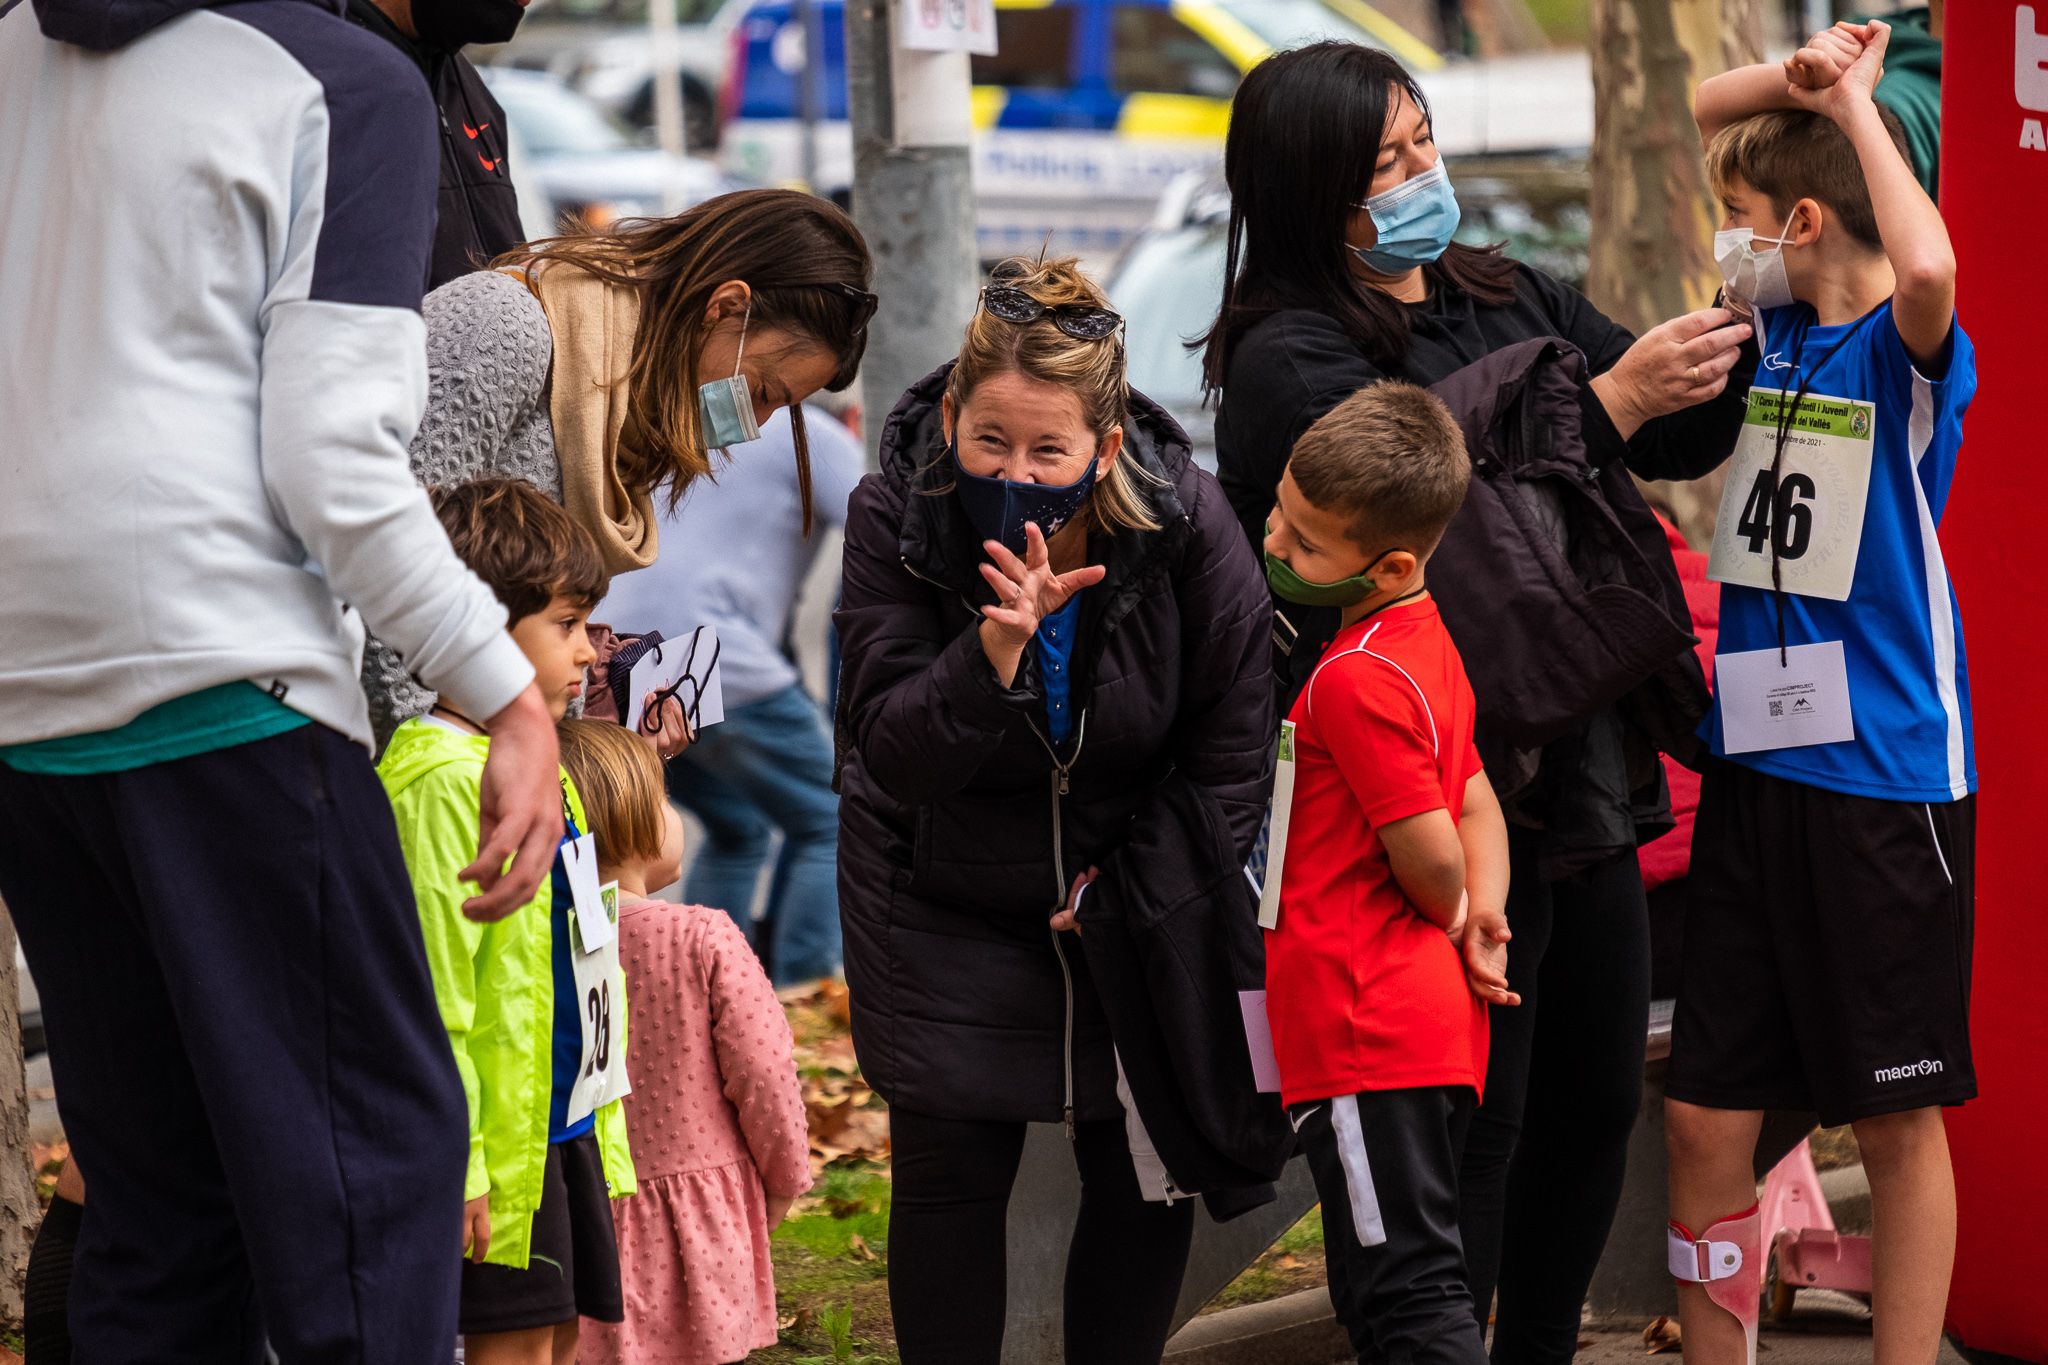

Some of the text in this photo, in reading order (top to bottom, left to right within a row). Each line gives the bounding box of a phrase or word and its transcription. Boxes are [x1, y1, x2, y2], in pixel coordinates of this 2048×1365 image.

[1760, 396, 1773, 407] Cursa
[1822, 404, 1848, 416] Juvenil
[1762, 412, 1769, 421] de
[1798, 416, 1808, 426] del
[1809, 416, 1831, 430] Vallès
[1798, 436, 1807, 445] de
[1807, 438, 1822, 447] 2021
[1737, 469, 1816, 561] 46
[583, 978, 610, 1080] 28
[1874, 1059, 1943, 1083] macron
